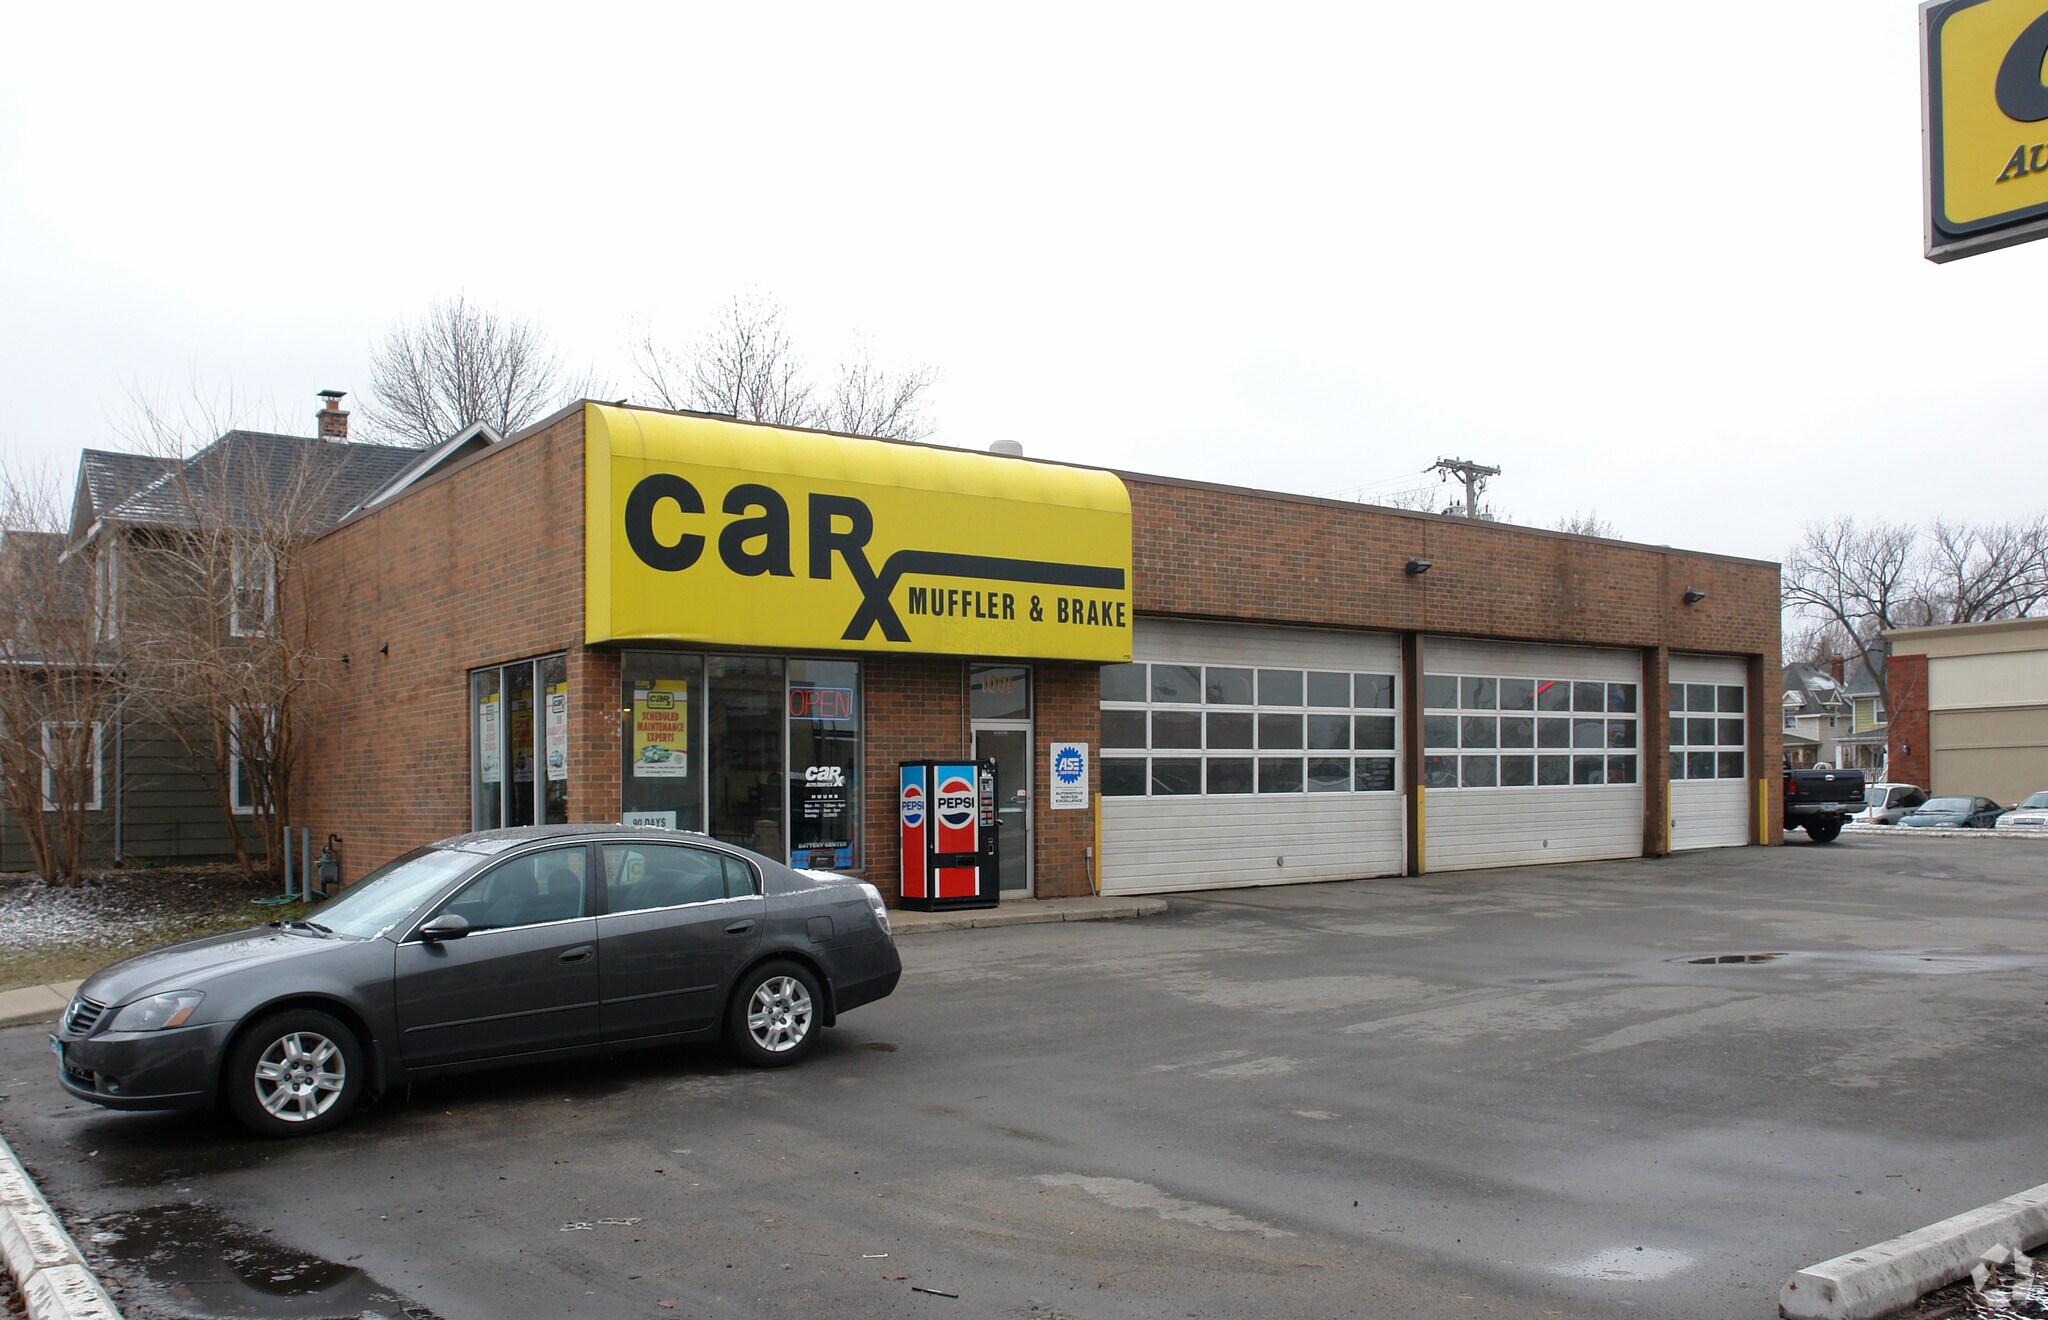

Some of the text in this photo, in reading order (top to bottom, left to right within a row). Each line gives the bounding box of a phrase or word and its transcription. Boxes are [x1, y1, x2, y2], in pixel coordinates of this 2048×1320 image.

[908, 586, 1127, 628] MUFFLER & BRAKE
[790, 689, 851, 718] OPEN
[642, 711, 679, 721] SCHEDULED
[637, 722, 684, 731] MAINTENANCE
[647, 733, 675, 742] EXPERTS
[1058, 757, 1080, 771] ASE
[902, 801, 924, 811] PEPSI
[938, 797, 975, 809] PEPSI
[645, 817, 666, 827] DAYS
